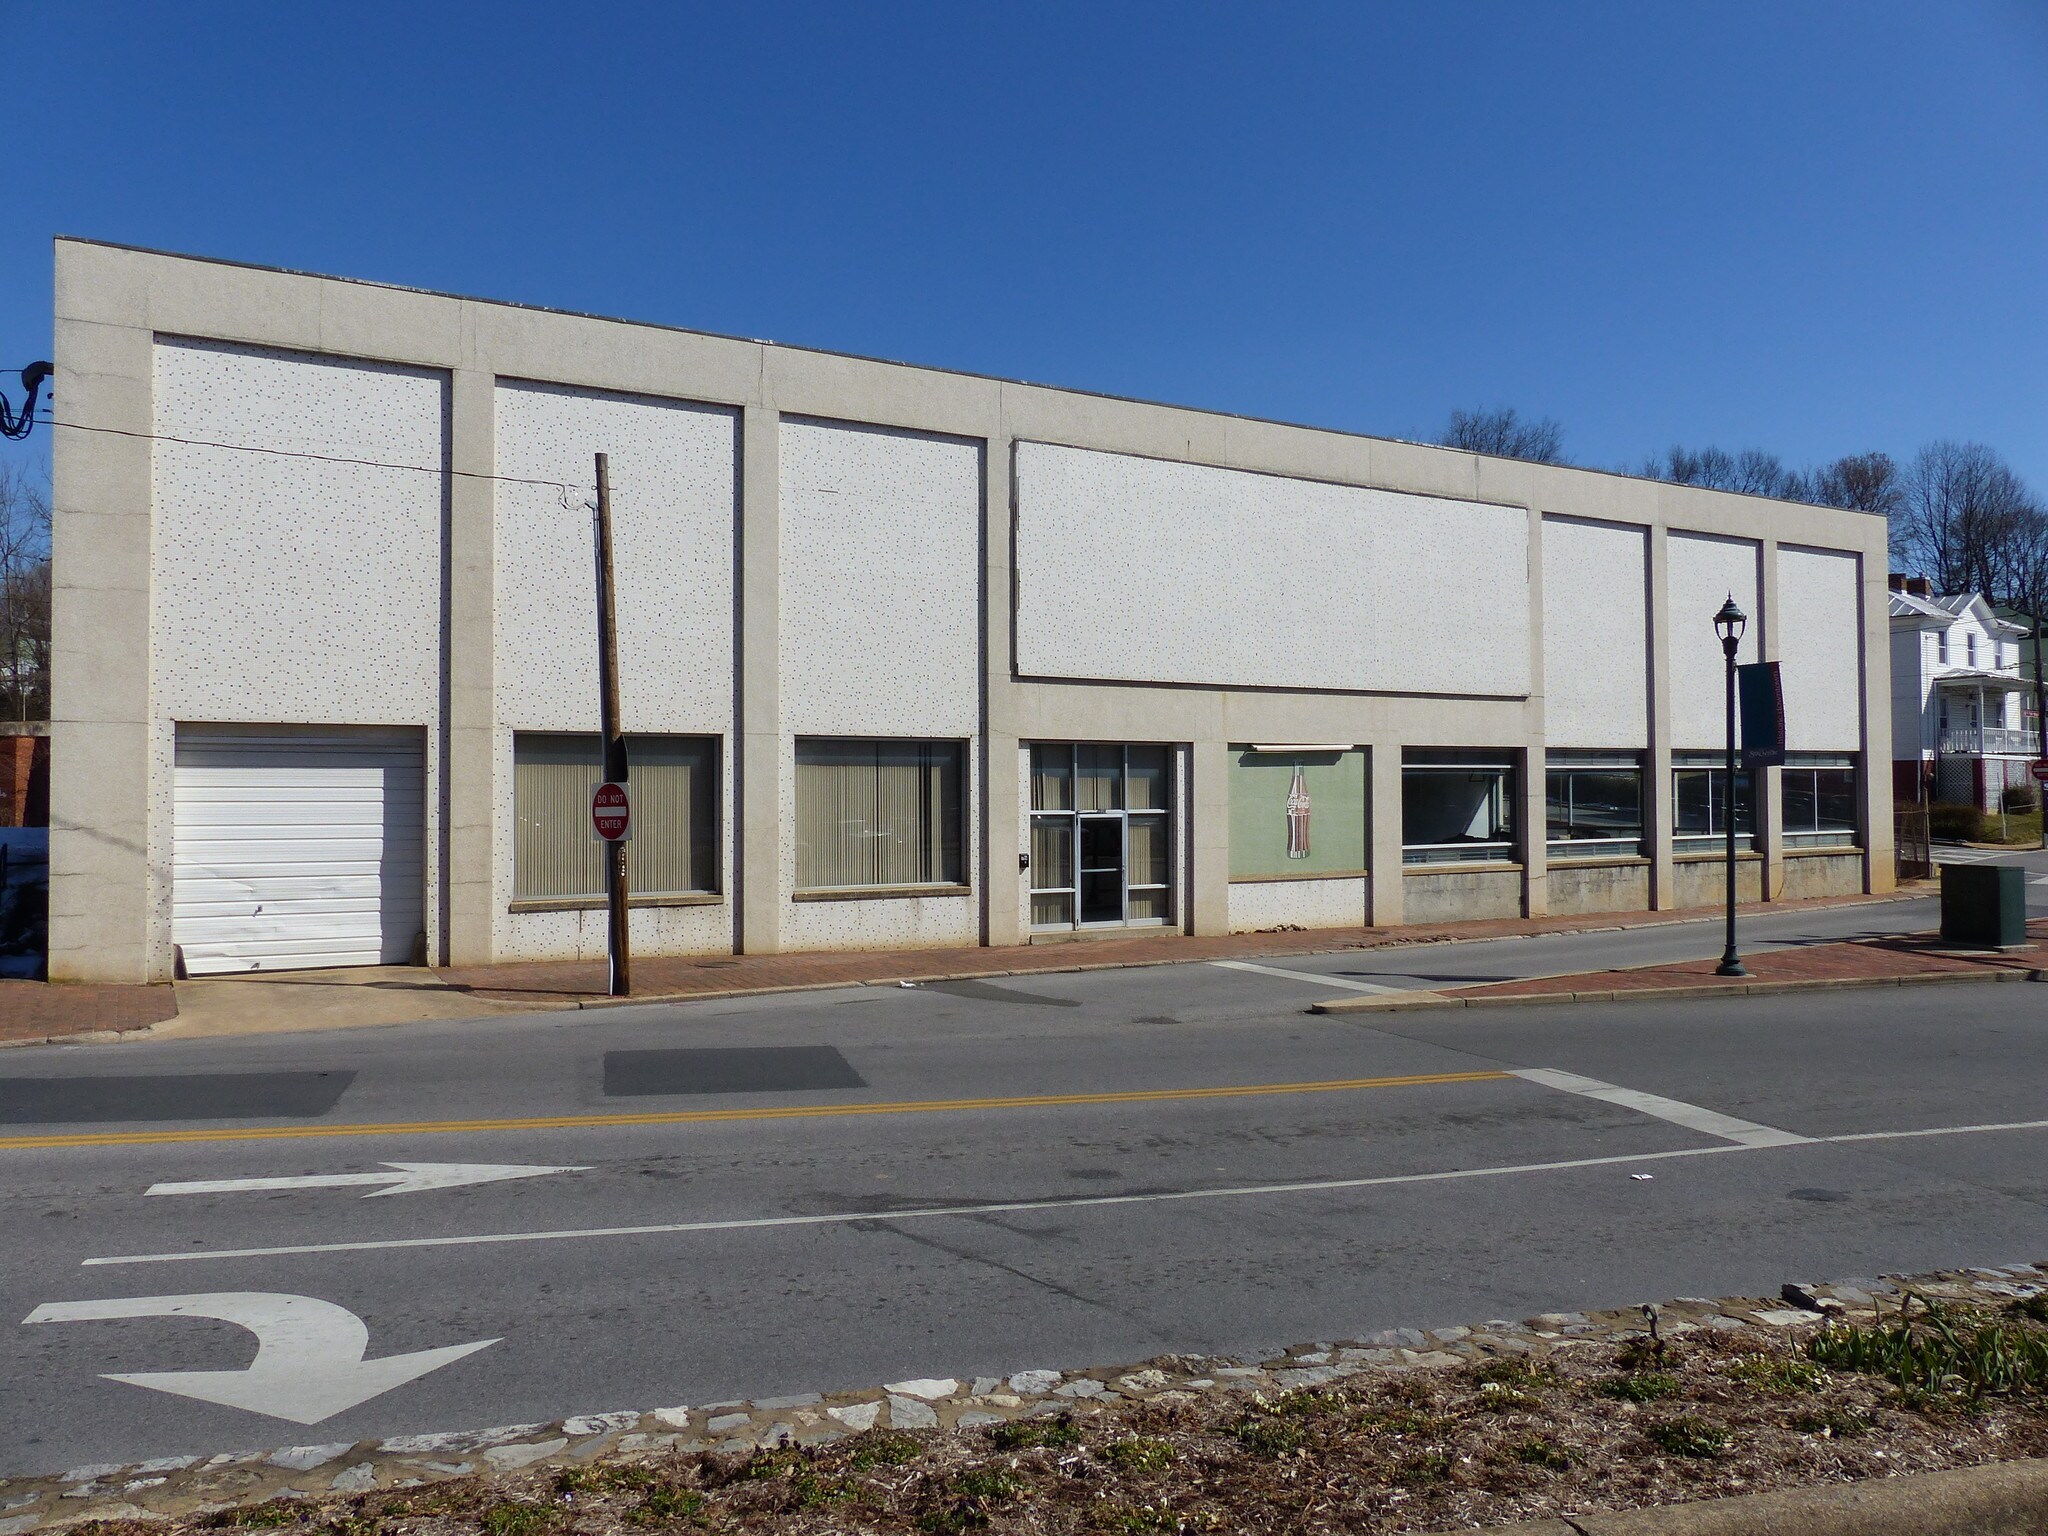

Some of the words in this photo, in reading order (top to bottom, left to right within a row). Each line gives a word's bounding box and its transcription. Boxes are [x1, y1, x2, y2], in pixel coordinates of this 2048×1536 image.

[597, 795, 607, 803] DO
[610, 794, 624, 803] NOT
[600, 819, 622, 829] ENTER
